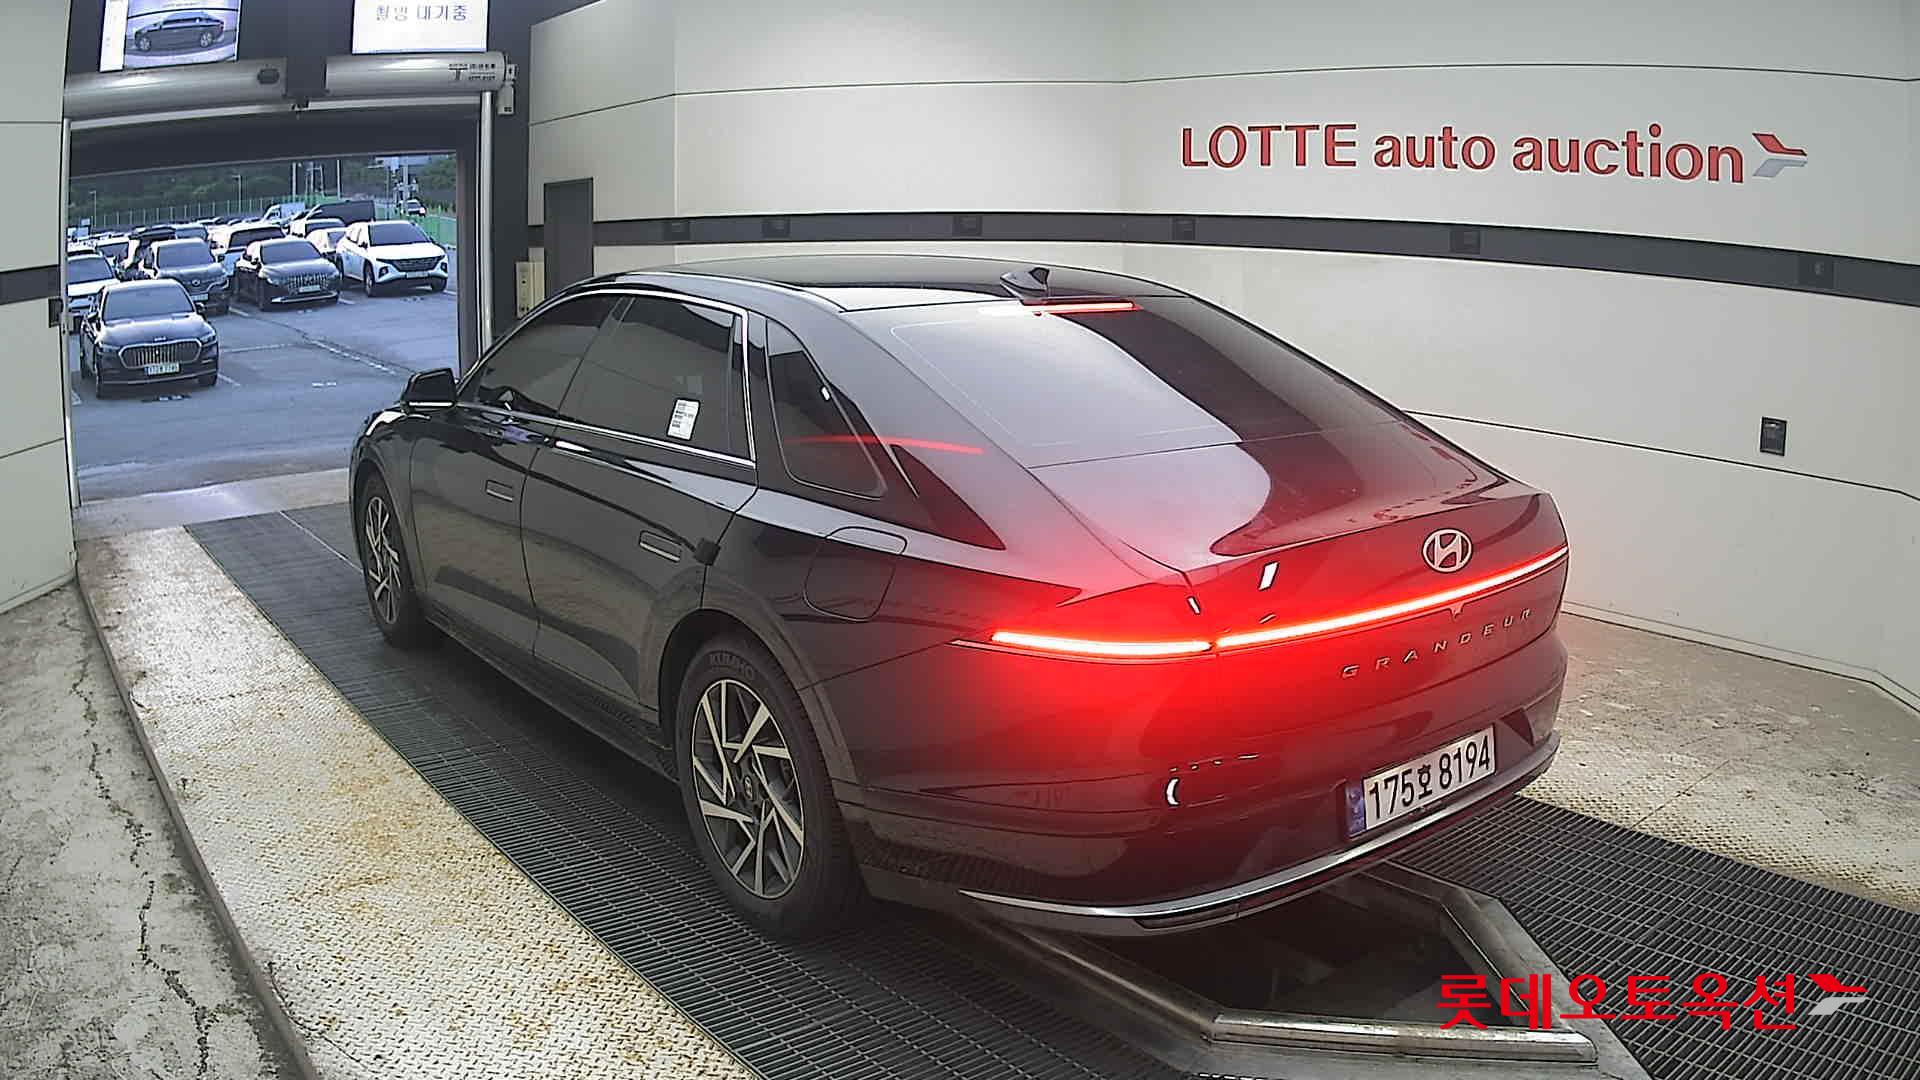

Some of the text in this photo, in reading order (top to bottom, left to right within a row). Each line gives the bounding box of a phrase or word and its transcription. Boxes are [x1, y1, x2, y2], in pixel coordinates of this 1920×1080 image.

[1181, 123, 1745, 184] LOTTE auto auction
[1340, 607, 1534, 679] GRANDEUR
[1369, 735, 1491, 819] 175호 8194
